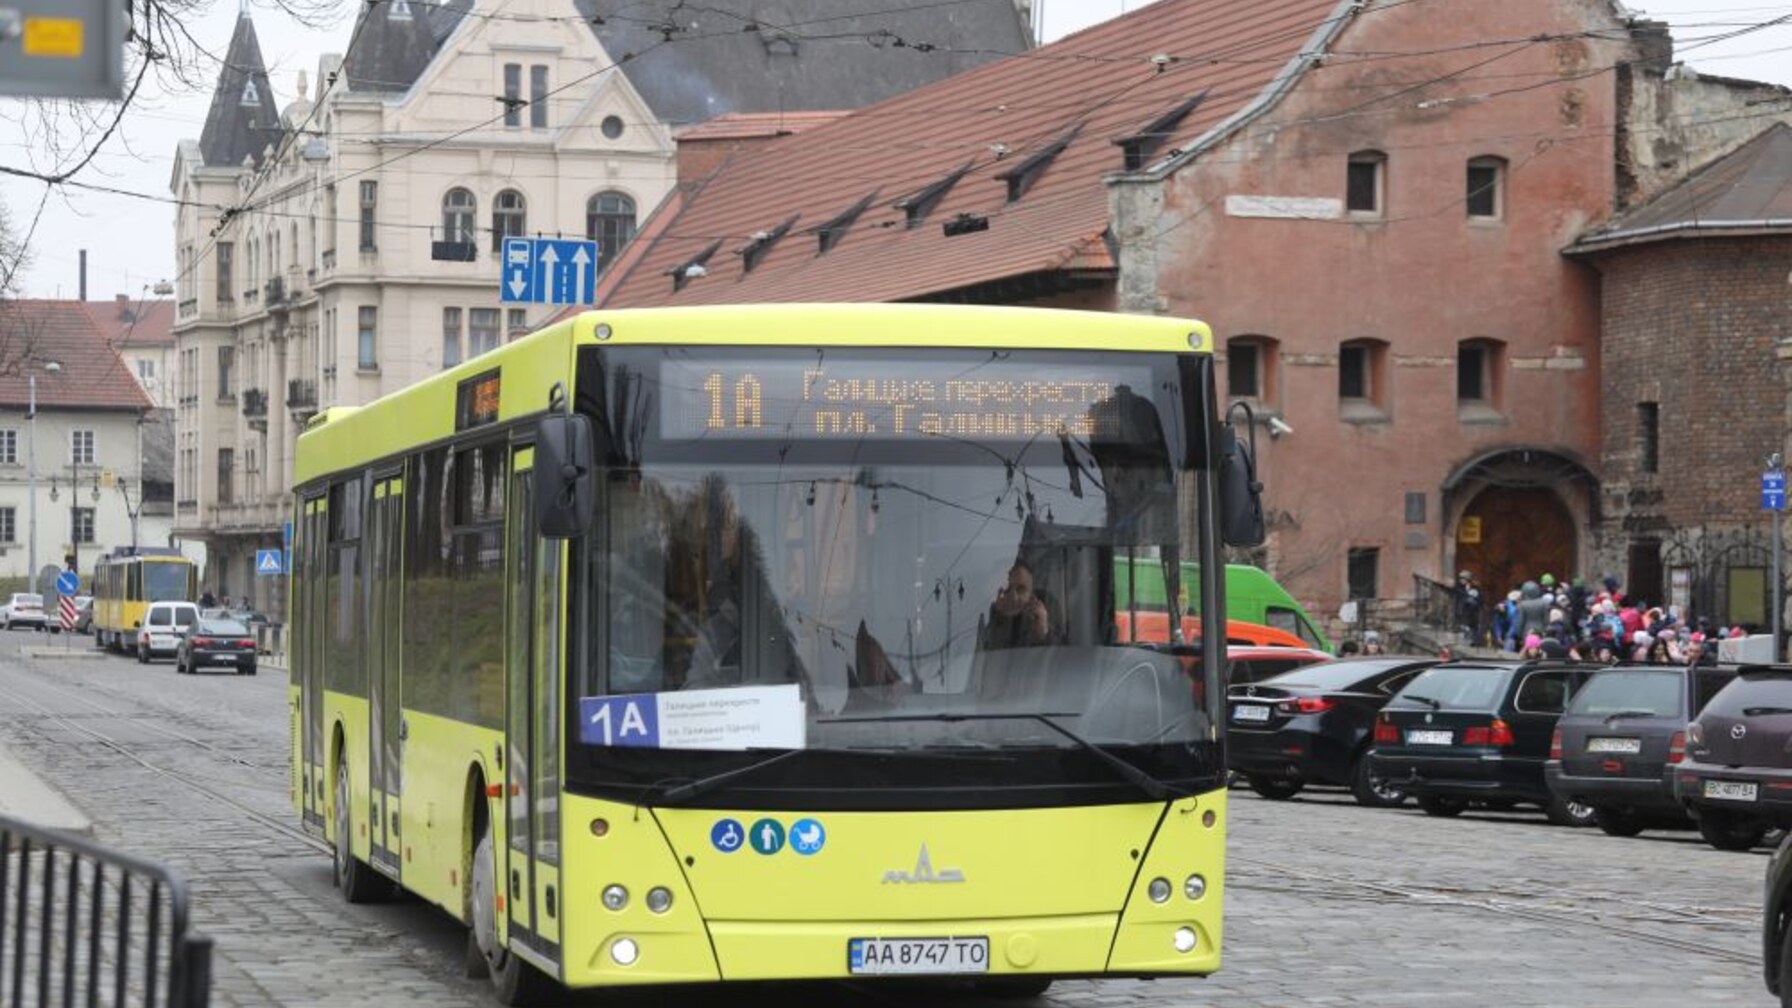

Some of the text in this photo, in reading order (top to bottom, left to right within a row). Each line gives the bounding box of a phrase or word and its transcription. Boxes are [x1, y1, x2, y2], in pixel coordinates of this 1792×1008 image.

[865, 943, 985, 964] AA 8747 TO
